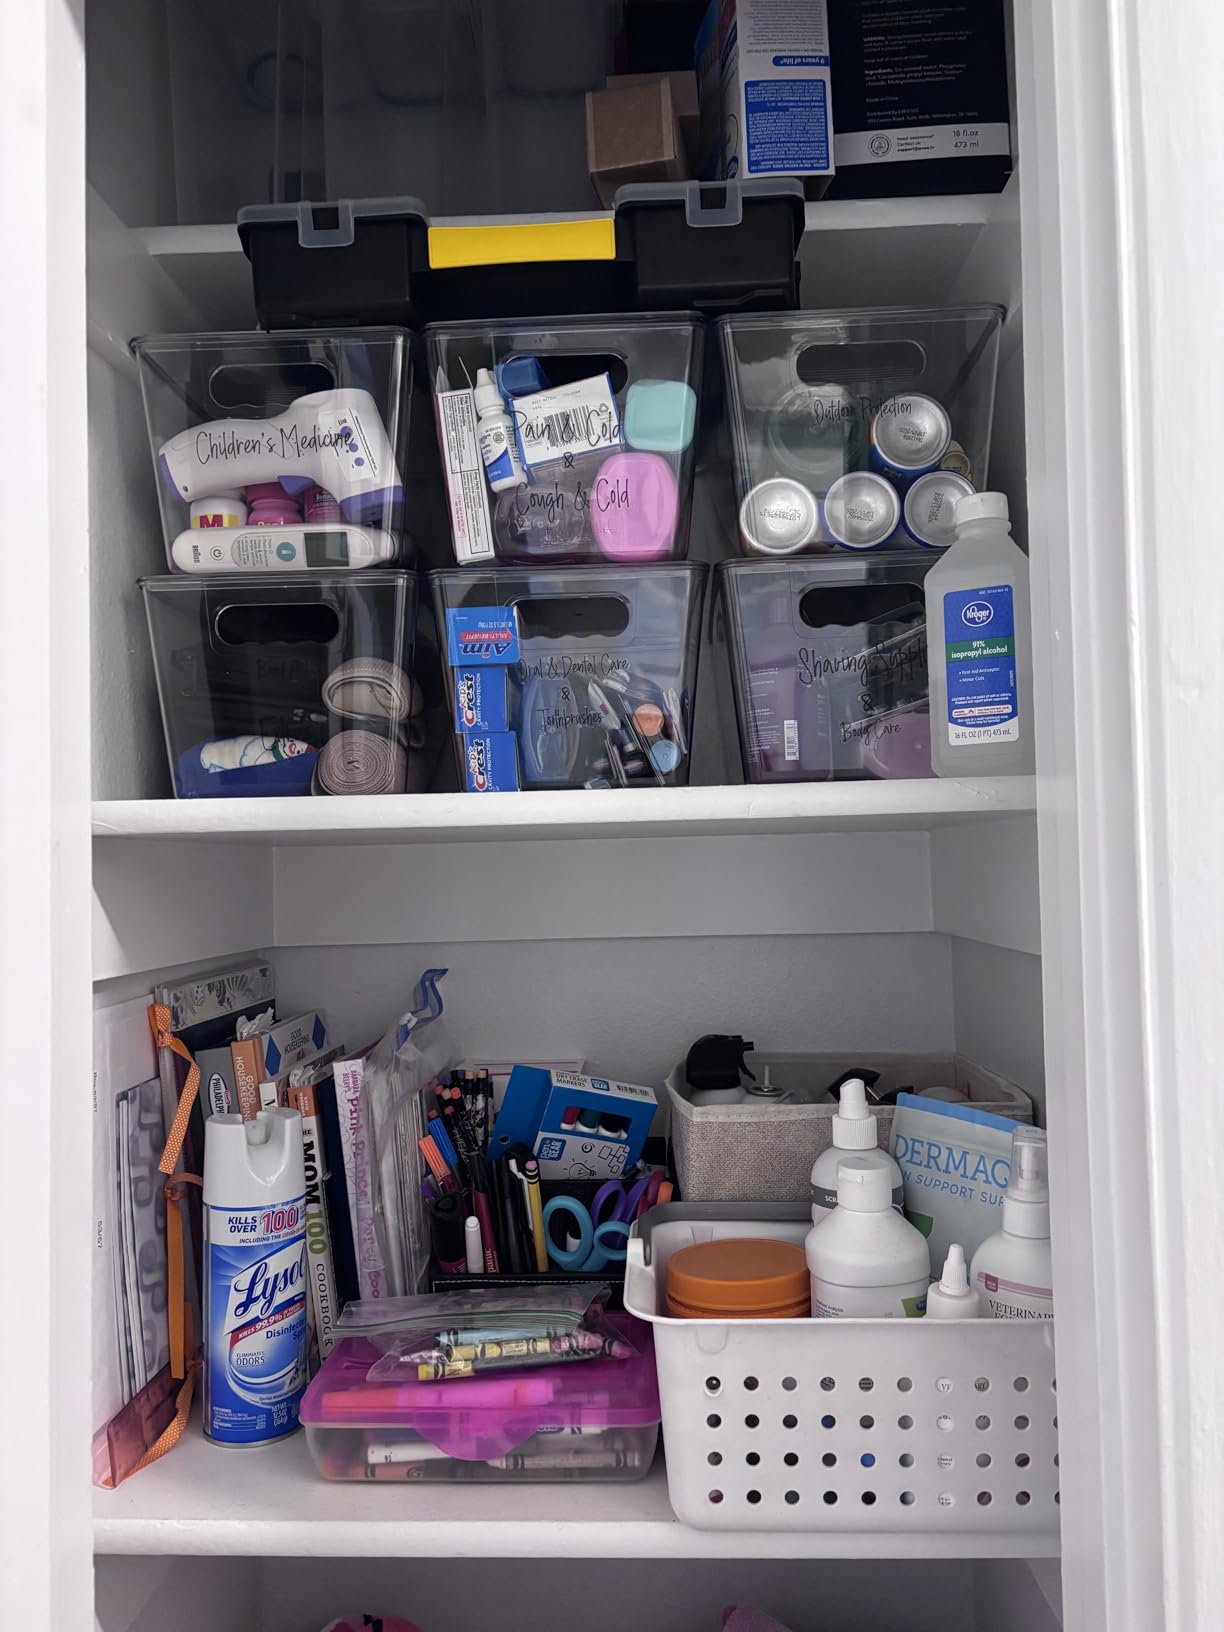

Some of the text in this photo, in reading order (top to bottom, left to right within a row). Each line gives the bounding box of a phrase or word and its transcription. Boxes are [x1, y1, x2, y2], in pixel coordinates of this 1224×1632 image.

[802, 56, 820, 64] years
[953, 140, 979, 149] 473 ml
[859, 395, 912, 420] Protection
[503, 410, 550, 447] Pain
[586, 409, 621, 447] Cold
[196, 430, 275, 464] Children's
[279, 424, 354, 458] Medicine
[563, 452, 575, 469] &
[515, 478, 630, 522] Cough & Cold
[966, 606, 990, 622] Kroger
[466, 632, 508, 640] MULTI-BENEFIT
[461, 642, 512, 658] Aim
[951, 645, 1008, 659] isopropyl alcohol
[519, 653, 630, 681] Oral & Dental Care
[799, 647, 868, 686] Shaving
[463, 673, 475, 726] Crest
[561, 686, 570, 701] &
[861, 693, 874, 711] &
[536, 708, 604, 733] Toothbrushes
[840, 718, 901, 746] Body Care
[474, 738, 487, 791] Crest
[246, 1075, 257, 1104] GOOD
[556, 1078, 586, 1087] MARKERS
[568, 1075, 588, 1083] ERASE
[347, 1096, 363, 1136] Pink
[550, 1140, 562, 1158] GEAR
[303, 1141, 321, 1205] MOM
[915, 1174, 974, 1199] SUPPORT
[228, 1216, 257, 1225] KILLS
[229, 1205, 299, 1235] OVER 100
[306, 1211, 327, 1255] 100
[485, 1247, 497, 1273] panic
[234, 1240, 306, 1318] Lysol
[238, 1328, 255, 1340] KILLS
[255, 1313, 283, 1331] 99.9%
[236, 1350, 265, 1358] ELIMINATES
[236, 1356, 265, 1366] ODORS
